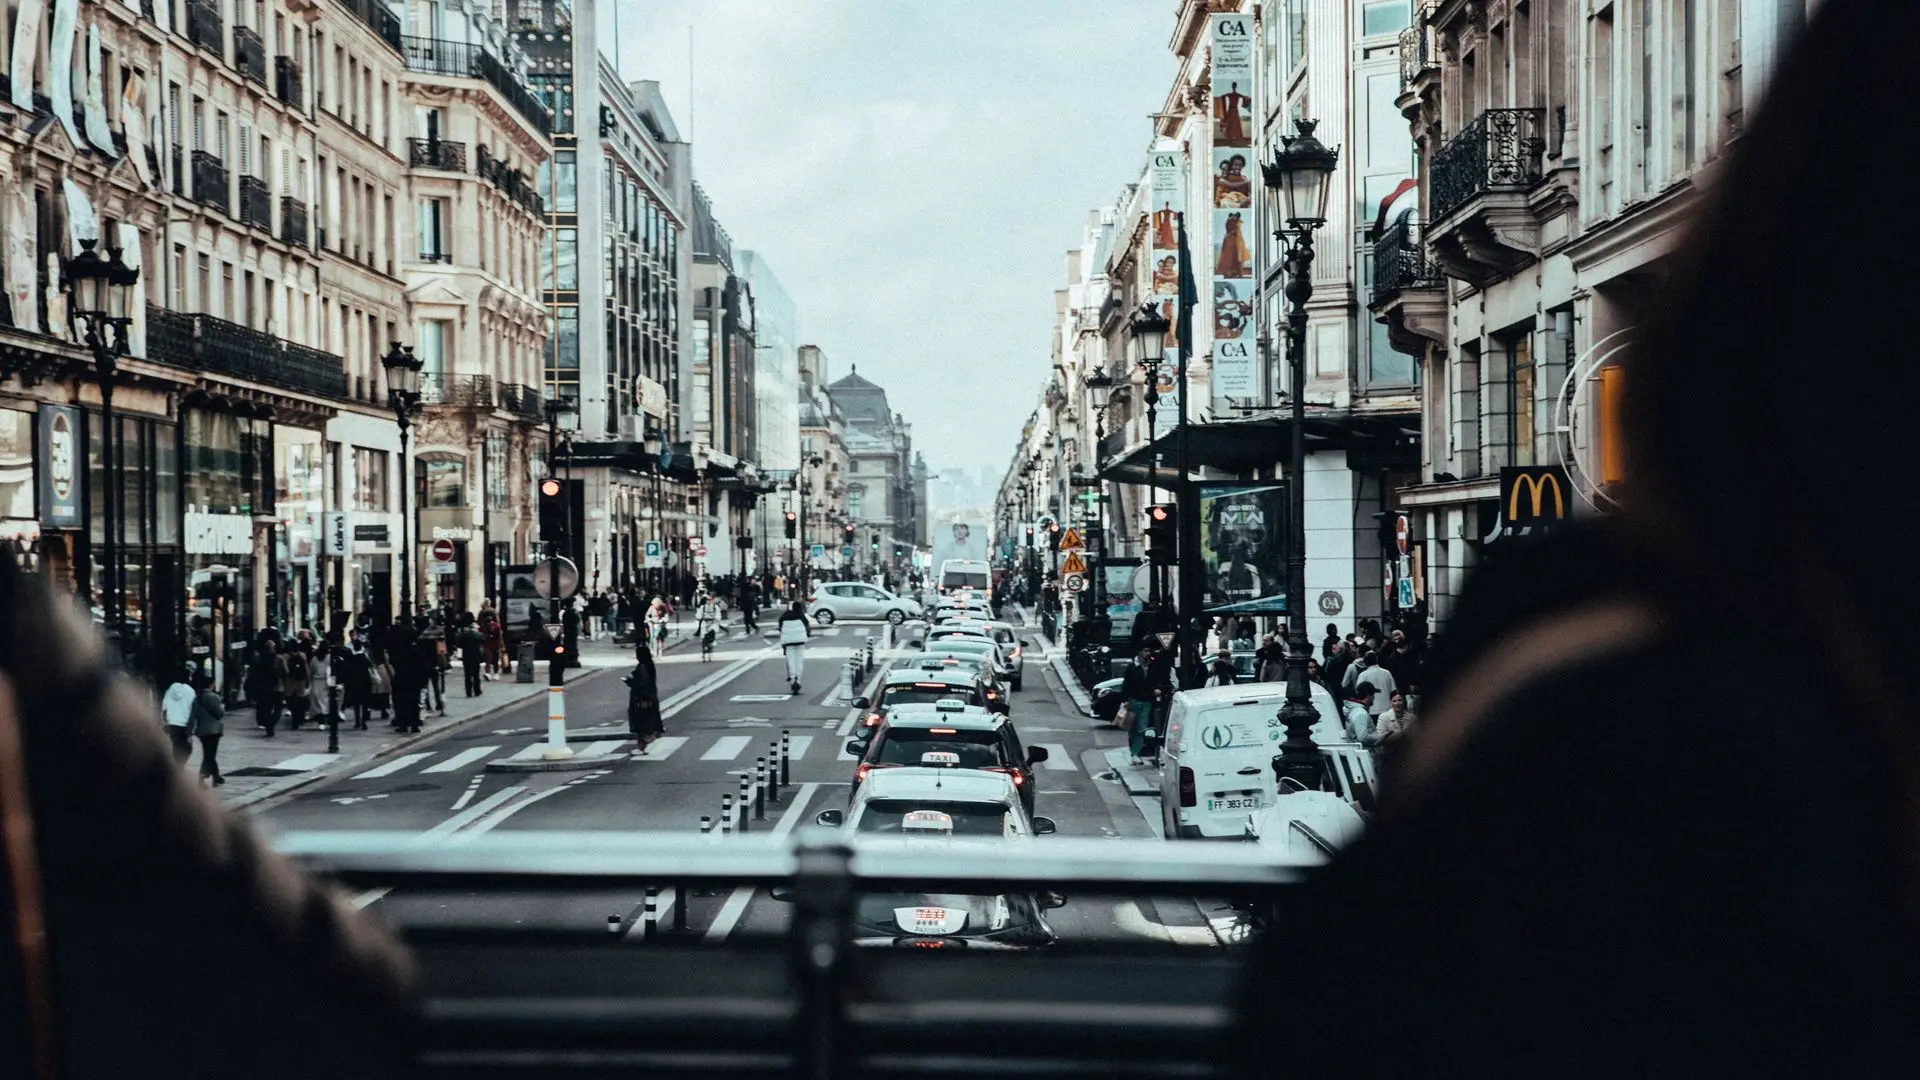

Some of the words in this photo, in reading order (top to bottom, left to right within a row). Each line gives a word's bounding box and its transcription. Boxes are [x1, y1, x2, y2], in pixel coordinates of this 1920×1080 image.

[1218, 20, 1247, 36] C&A
[1155, 155, 1176, 168] C&A
[1221, 342, 1249, 357] C&A
[648, 544, 658, 554] P
[1322, 597, 1341, 610] C&A
[929, 754, 952, 762] TAXI
